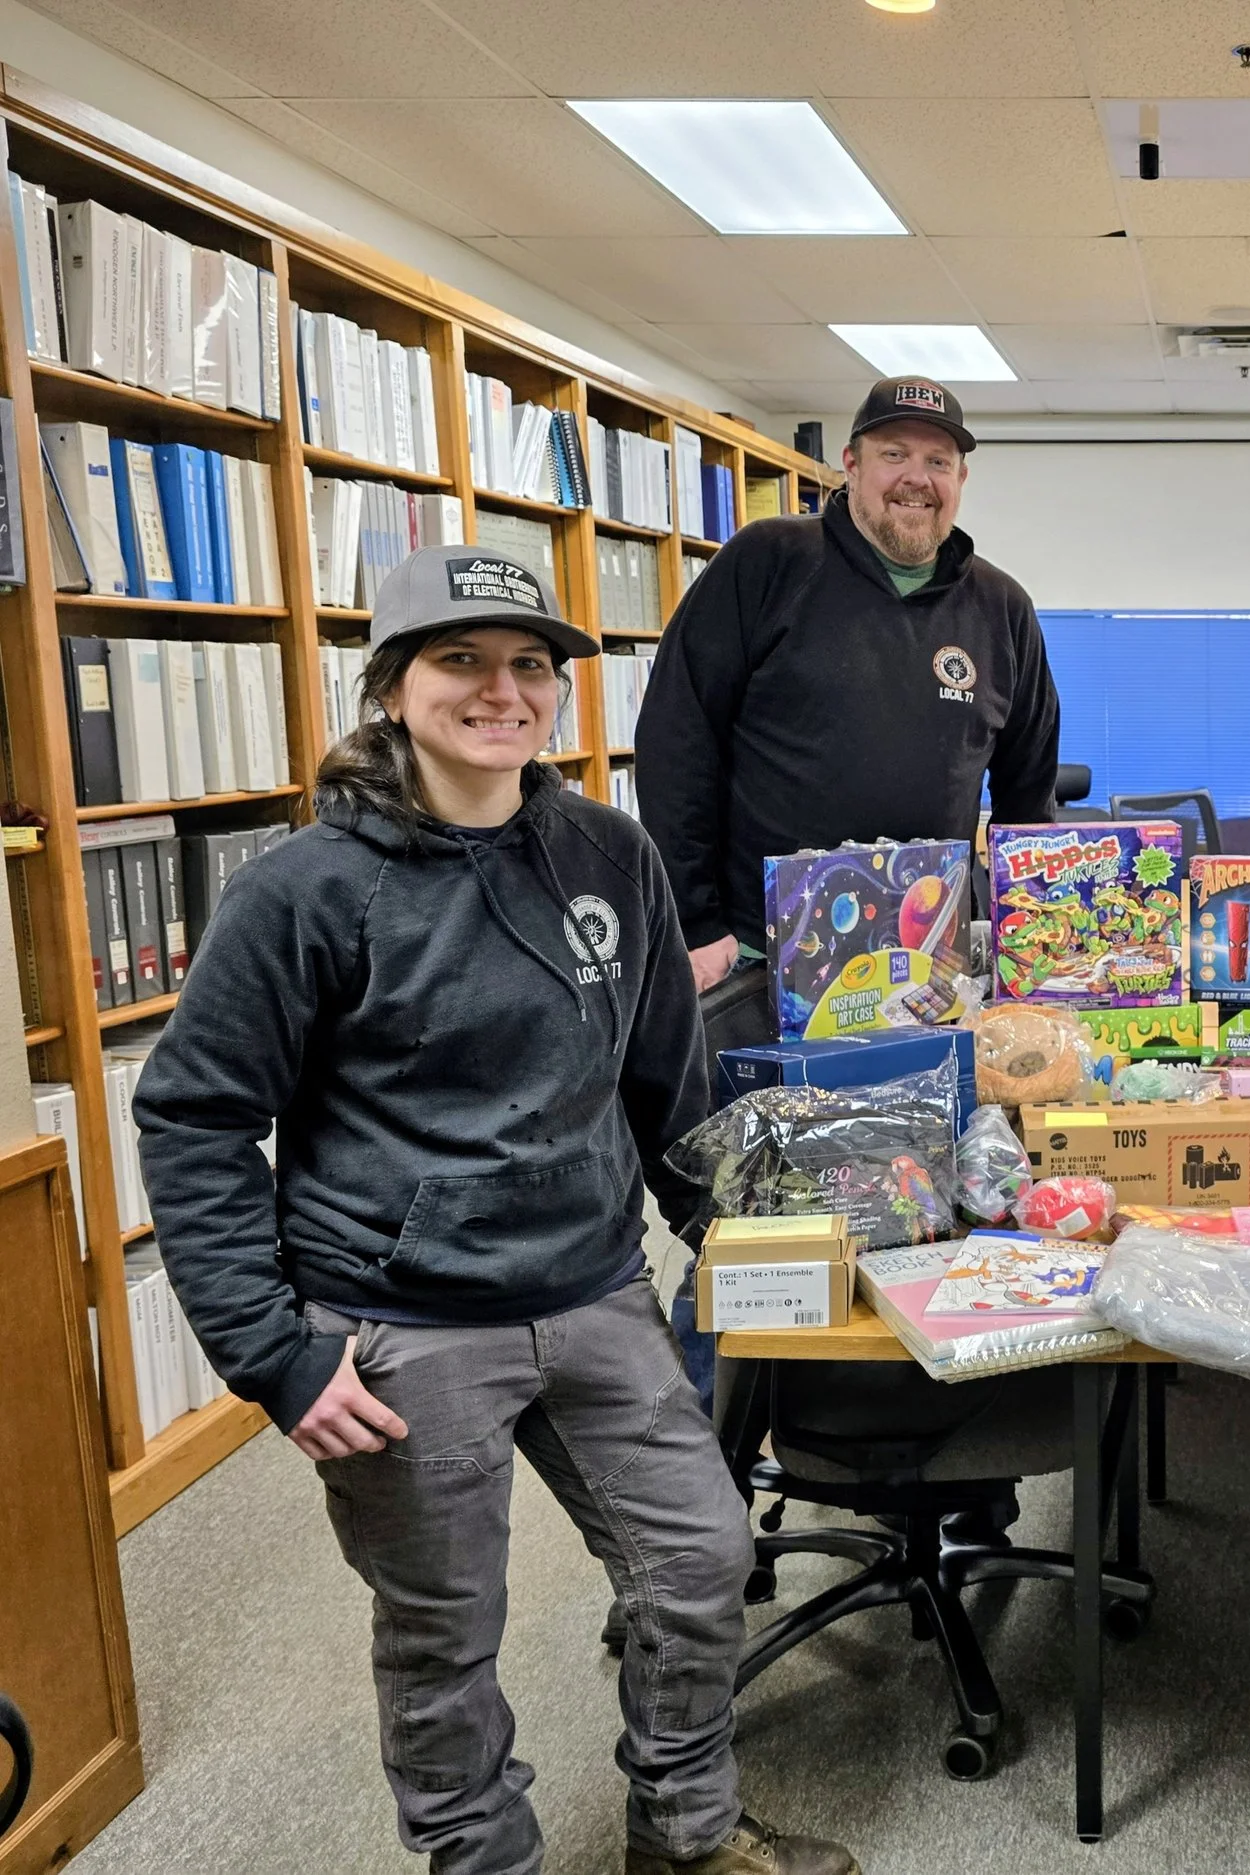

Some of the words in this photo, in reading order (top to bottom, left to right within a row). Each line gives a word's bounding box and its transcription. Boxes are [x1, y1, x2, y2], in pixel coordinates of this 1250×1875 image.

[897, 386, 943, 407] IBEW
[469, 560, 505, 574] Local
[505, 566, 524, 578] 77
[453, 572, 505, 587] INTERNATIONAL
[463, 585, 472, 596] OF
[473, 585, 513, 600] ELECTRICAL
[939, 687, 964, 702] LOCAL
[964, 691, 974, 704] 77
[1002, 838, 1038, 855] HUNGRY
[1041, 834, 1076, 850] HUNGRY
[1008, 838, 1119, 880] Hippos
[1061, 855, 1120, 884] TURTLES
[845, 960, 871, 977] Crayola
[891, 954, 908, 970] 140
[576, 963, 611, 984] LOC
[611, 962, 622, 979] 77
[891, 970, 909, 982] pieces
[1107, 964, 1177, 998] TURTLES
[829, 988, 882, 1013] INSPIRATION
[837, 1009, 855, 1028] ART
[854, 1006, 875, 1023] CASE
[53, 1109, 63, 1136] BUIL
[1113, 1129, 1147, 1148] TOYS
[816, 1166, 851, 1184] 120
[859, 1215, 882, 1225] Shading
[861, 1223, 877, 1232] Paper
[866, 1250, 943, 1272] SKETCH
[874, 1259, 935, 1277] BOOK
[718, 1271, 742, 1280] Cont.:
[750, 1271, 763, 1279] Set
[776, 1269, 814, 1278] Ensemble
[719, 1279, 724, 1287] 1
[726, 1279, 737, 1287] Kit
